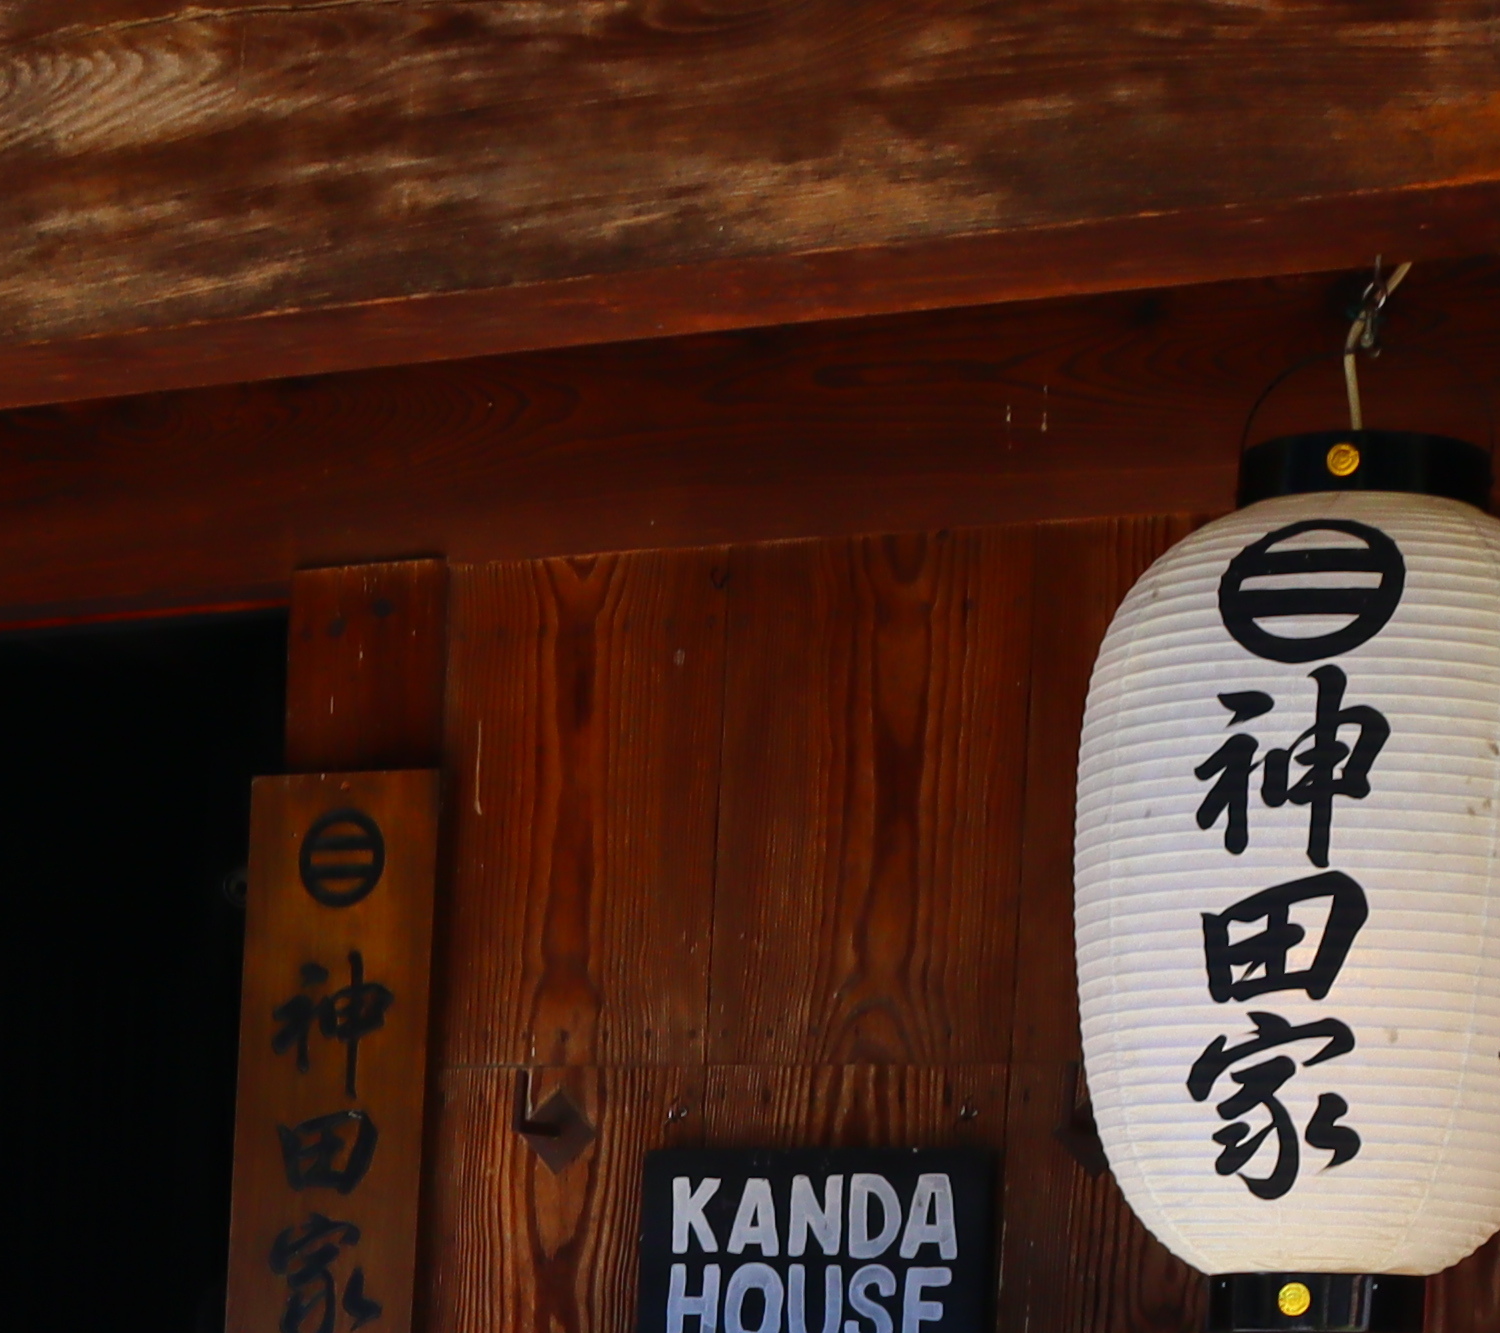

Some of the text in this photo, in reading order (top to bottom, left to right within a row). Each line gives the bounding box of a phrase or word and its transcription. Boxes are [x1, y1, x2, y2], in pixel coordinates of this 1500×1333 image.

[1188, 664, 1391, 1200] 神田家
[671, 1173, 958, 1260] KANDA
